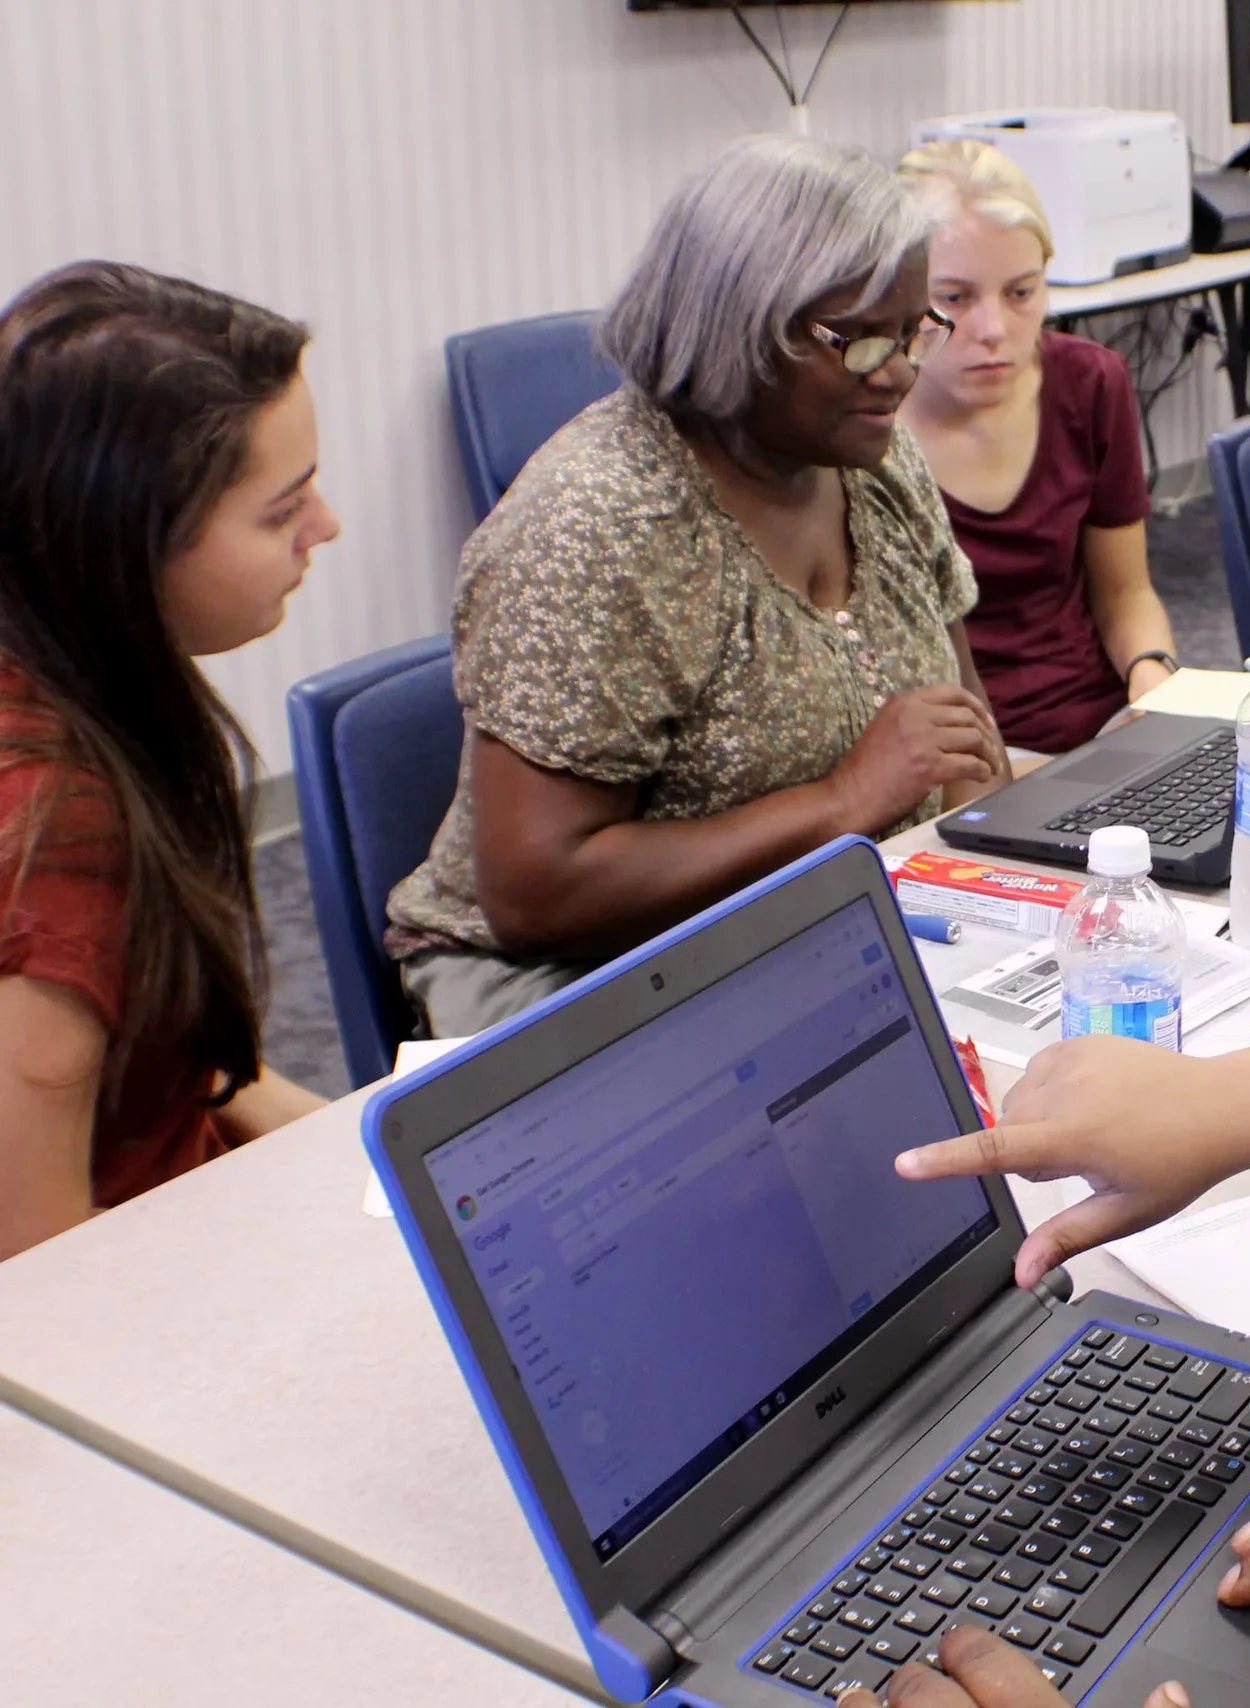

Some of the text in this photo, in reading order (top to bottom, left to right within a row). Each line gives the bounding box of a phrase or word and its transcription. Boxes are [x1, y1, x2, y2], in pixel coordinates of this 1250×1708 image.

[983, 873, 1040, 885] Butter
[1001, 881, 1059, 893] Nutter
[473, 1222, 512, 1251] Google
[815, 1386, 847, 1420] DELL
[862, 1618, 875, 1627] 2
[889, 1590, 900, 1599] 3
[940, 1537, 951, 1546] 5
[987, 1489, 998, 1497] 7
[875, 1641, 890, 1650] Q
[901, 1610, 916, 1622] W
[928, 1587, 941, 1596] E
[952, 1560, 966, 1569] R
[977, 1533, 989, 1542] T
[1001, 1509, 1014, 1519] Y
[1023, 1485, 1037, 1494] U
[1069, 1440, 1081, 1449] O
[1089, 1418, 1099, 1426] P
[926, 1448, 1125, 1663] A D F G H J K L
[1007, 1494, 1137, 1637] X C V B N M
